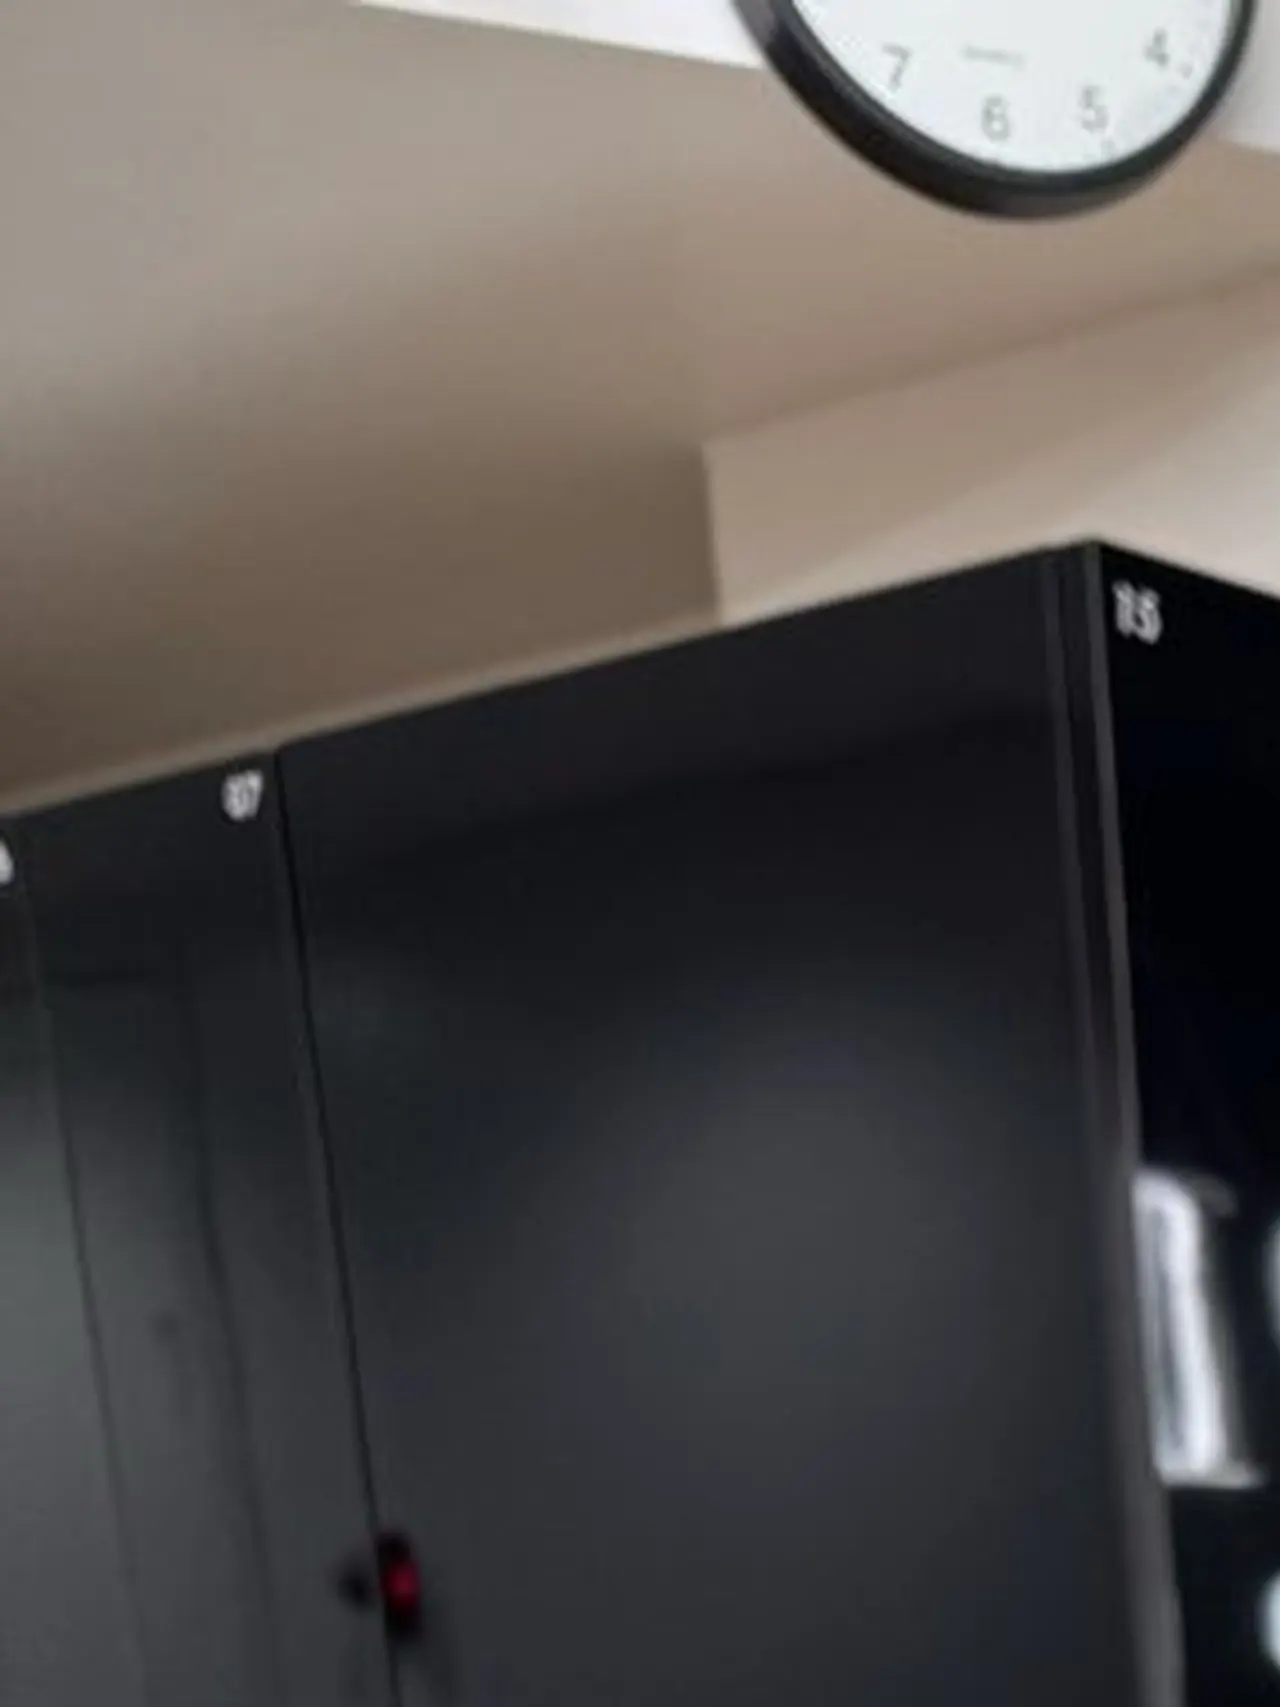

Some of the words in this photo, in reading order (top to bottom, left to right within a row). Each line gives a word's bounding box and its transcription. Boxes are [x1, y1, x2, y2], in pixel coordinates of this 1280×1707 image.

[882, 45, 912, 90] 7
[1142, 28, 1171, 69] 4
[980, 95, 1011, 142] 6
[1078, 85, 1109, 133] 5
